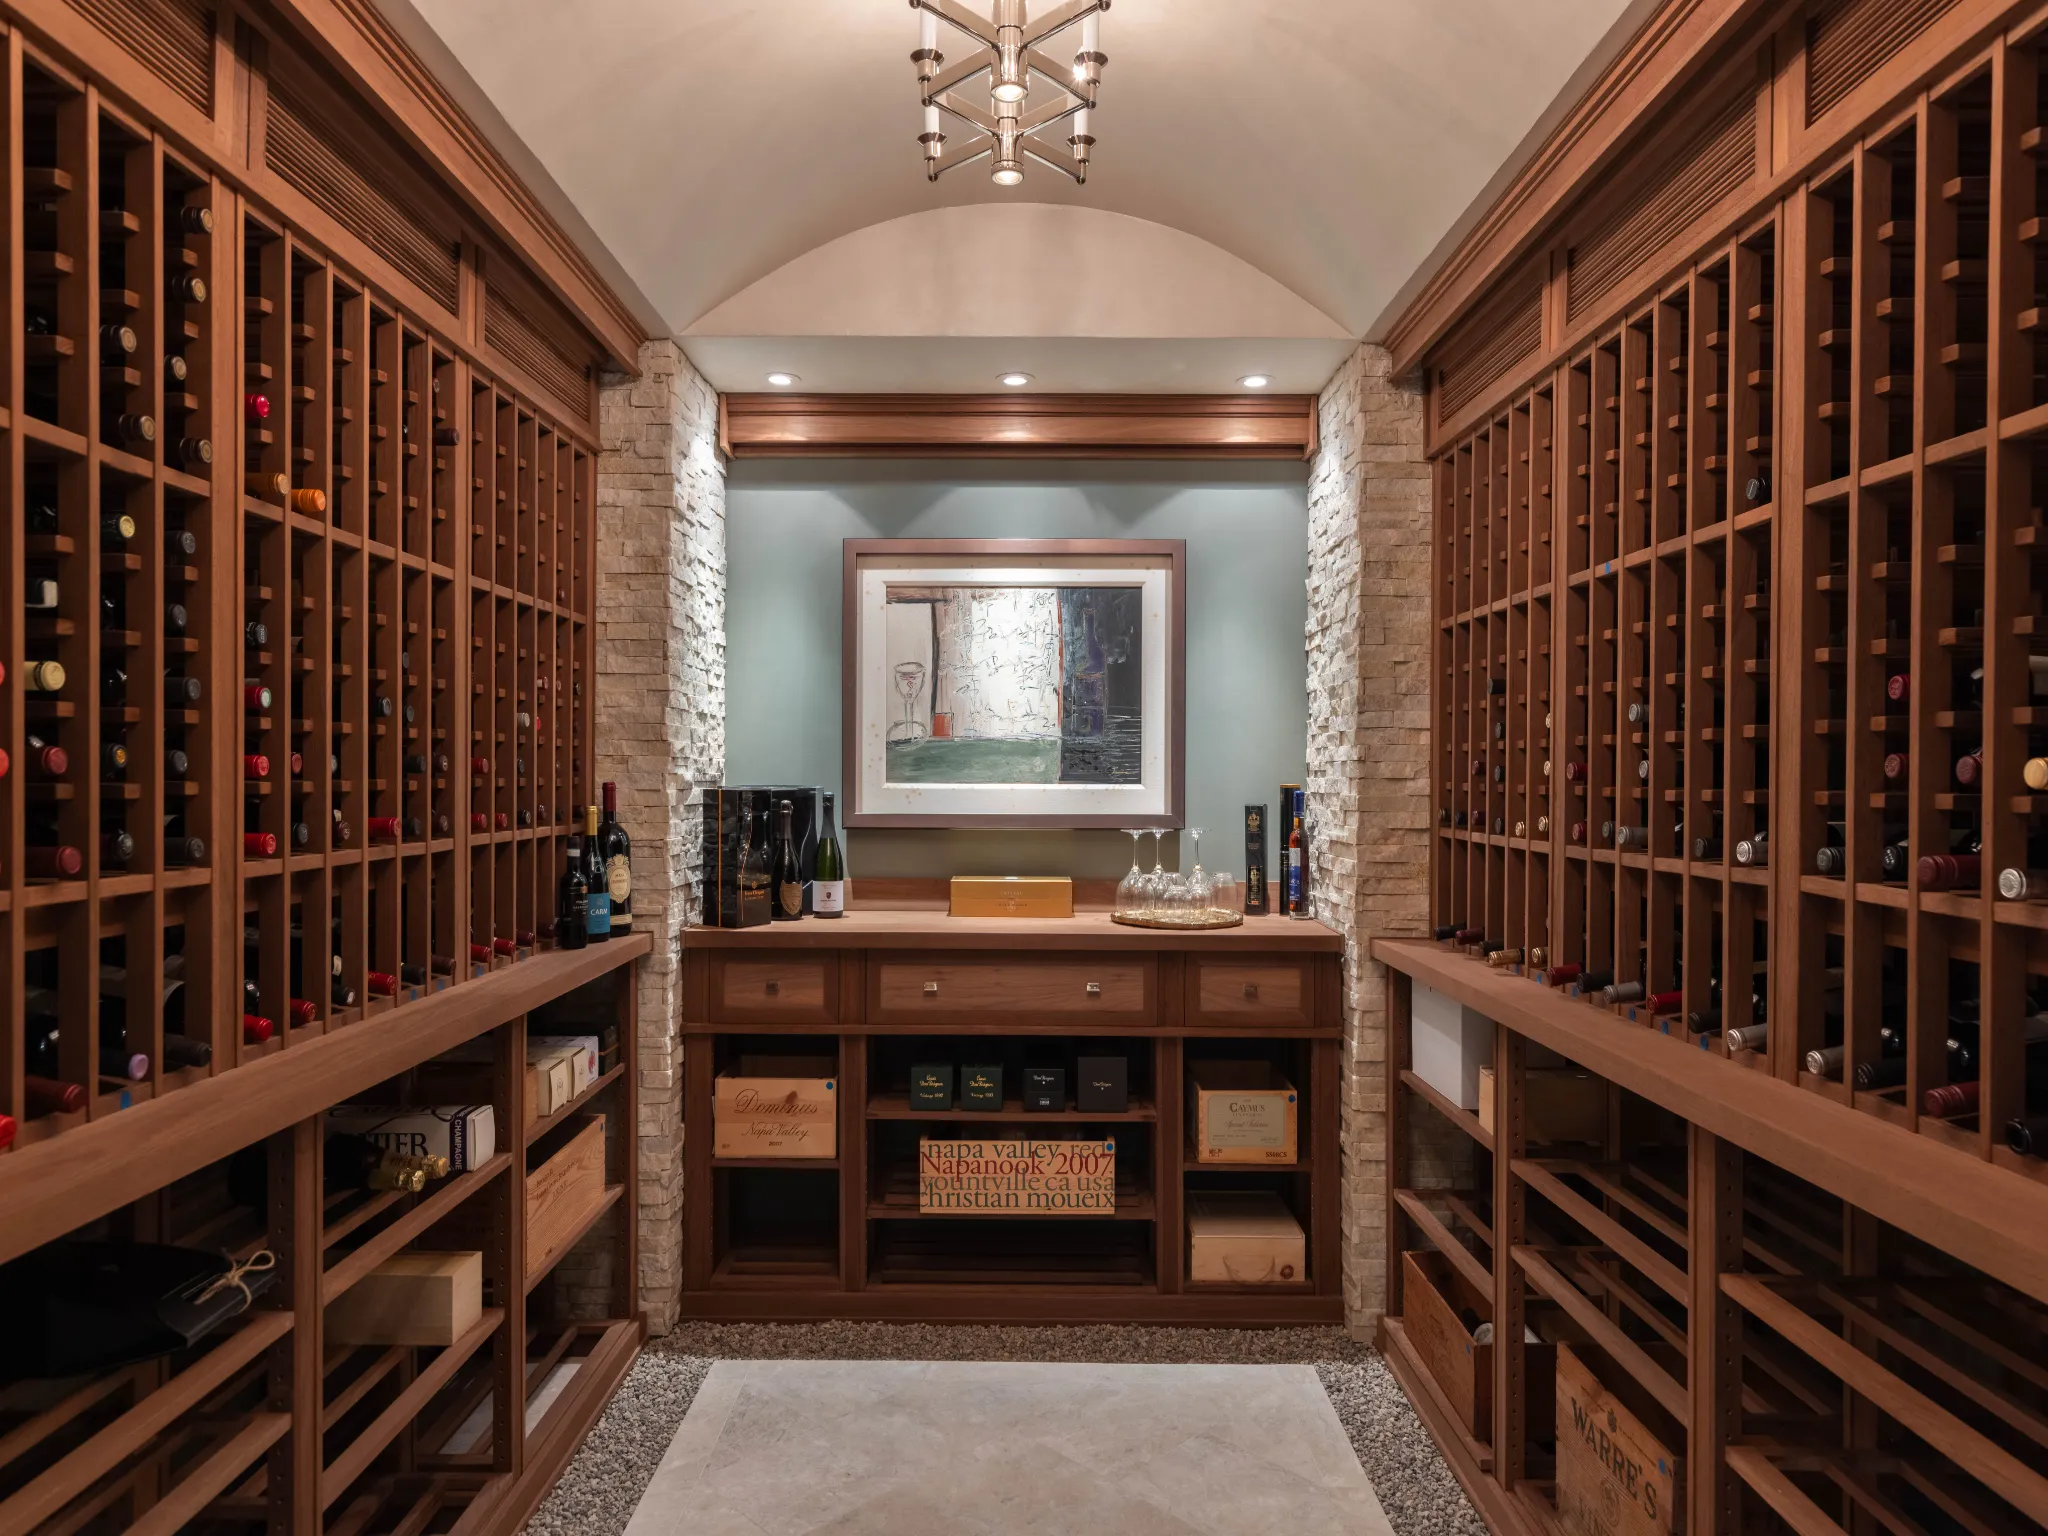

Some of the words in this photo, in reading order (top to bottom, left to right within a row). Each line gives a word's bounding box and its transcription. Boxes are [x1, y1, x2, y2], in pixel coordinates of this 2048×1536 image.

[734, 1088, 818, 1115] Dominus
[1230, 1103, 1265, 1113] CAYMUS
[454, 1119, 463, 1171] CHAMPAGNE
[741, 1121, 772, 1140] Napa
[771, 1121, 810, 1142] Valley
[921, 1150, 1046, 1183] Napanook
[1055, 1152, 1115, 1177] 2007
[927, 1142, 984, 1165] napa
[993, 1141, 1061, 1166] valley
[1070, 1141, 1106, 1159] red
[921, 1167, 1041, 1195] yountville
[1044, 1175, 1071, 1192] ca
[1077, 1175, 1115, 1192] usa
[920, 1182, 1021, 1209] christian
[1026, 1190, 1116, 1209] moueix
[1571, 1396, 1657, 1520] WARRE'S
